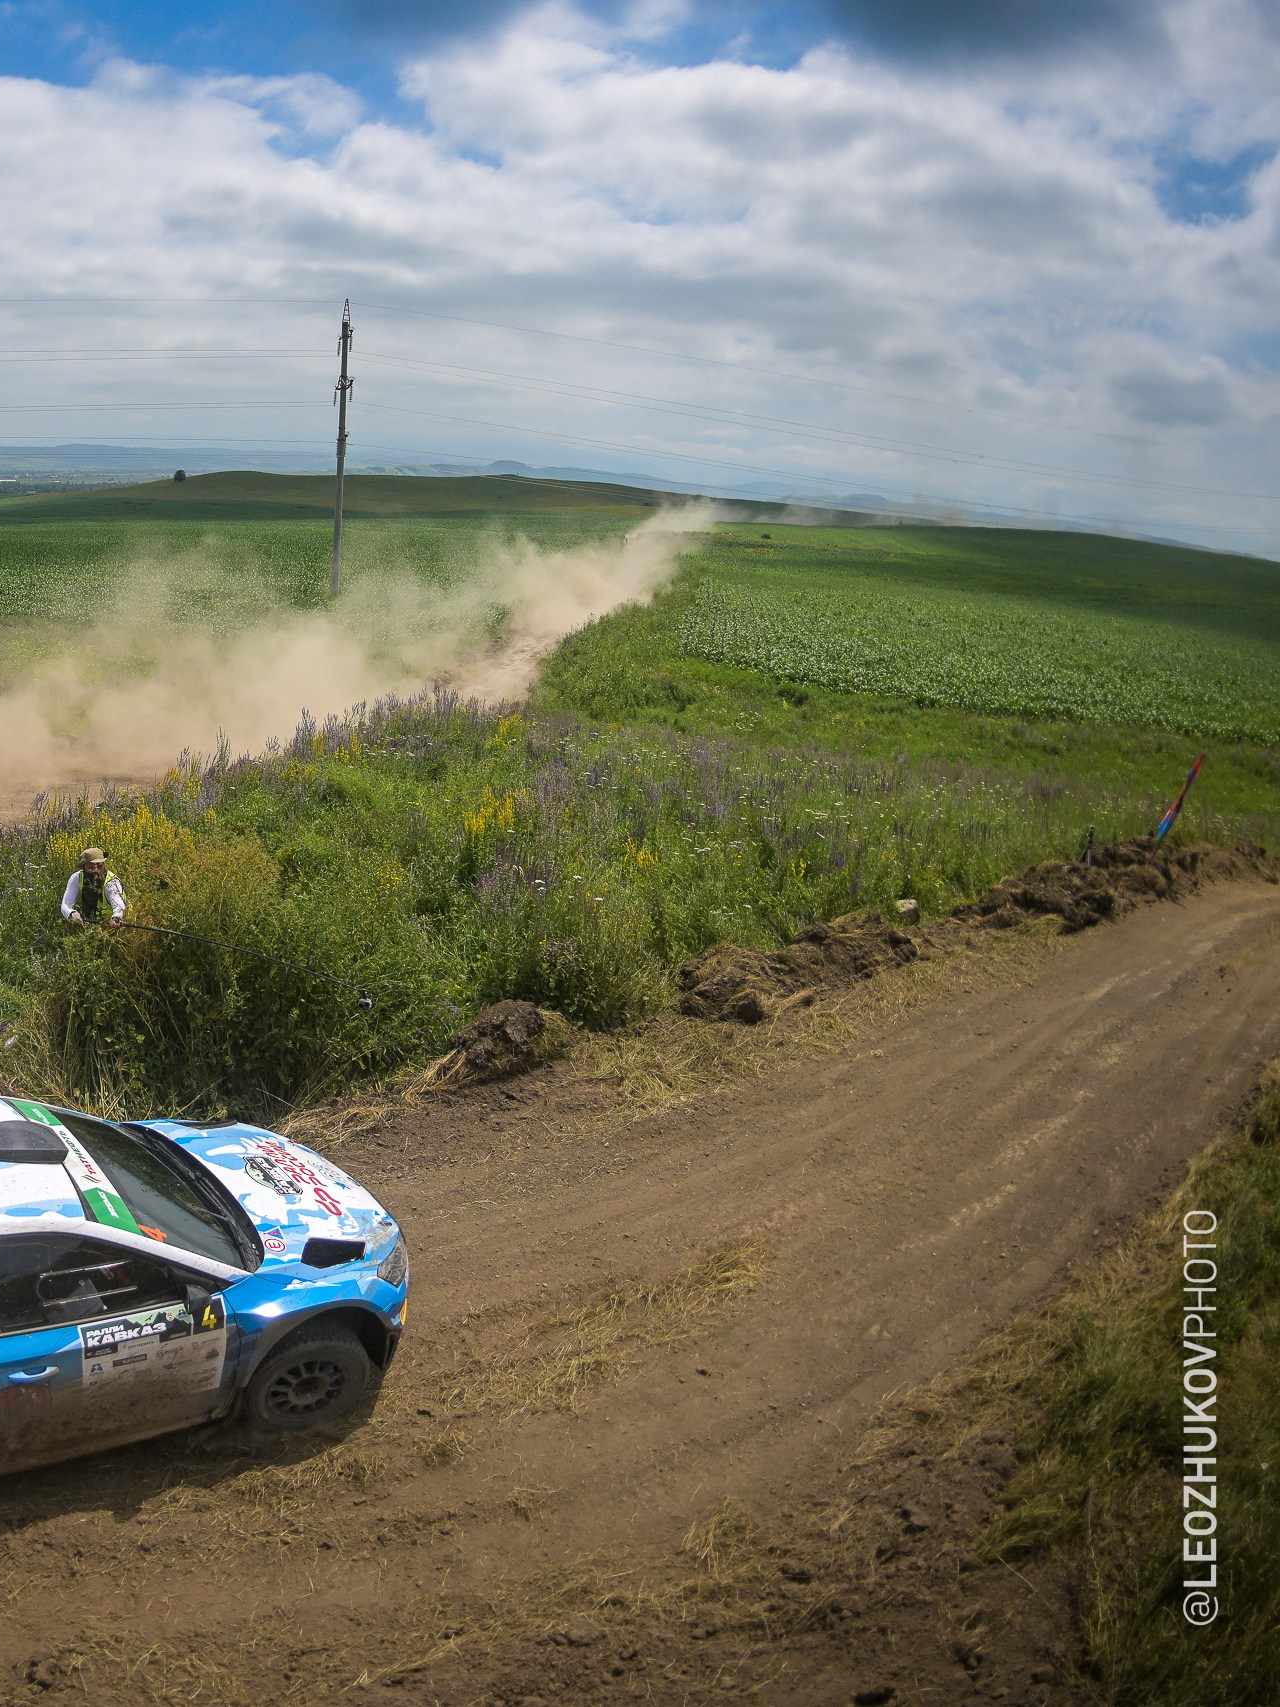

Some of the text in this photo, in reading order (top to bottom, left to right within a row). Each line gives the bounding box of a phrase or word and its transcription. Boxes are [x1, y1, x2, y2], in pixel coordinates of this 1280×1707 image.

[138, 1223, 168, 1243] 4
[201, 1305, 217, 1329] 4
[86, 1324, 125, 1337] РАЛЛИ
[87, 1322, 167, 1348] КАВКАЗ
